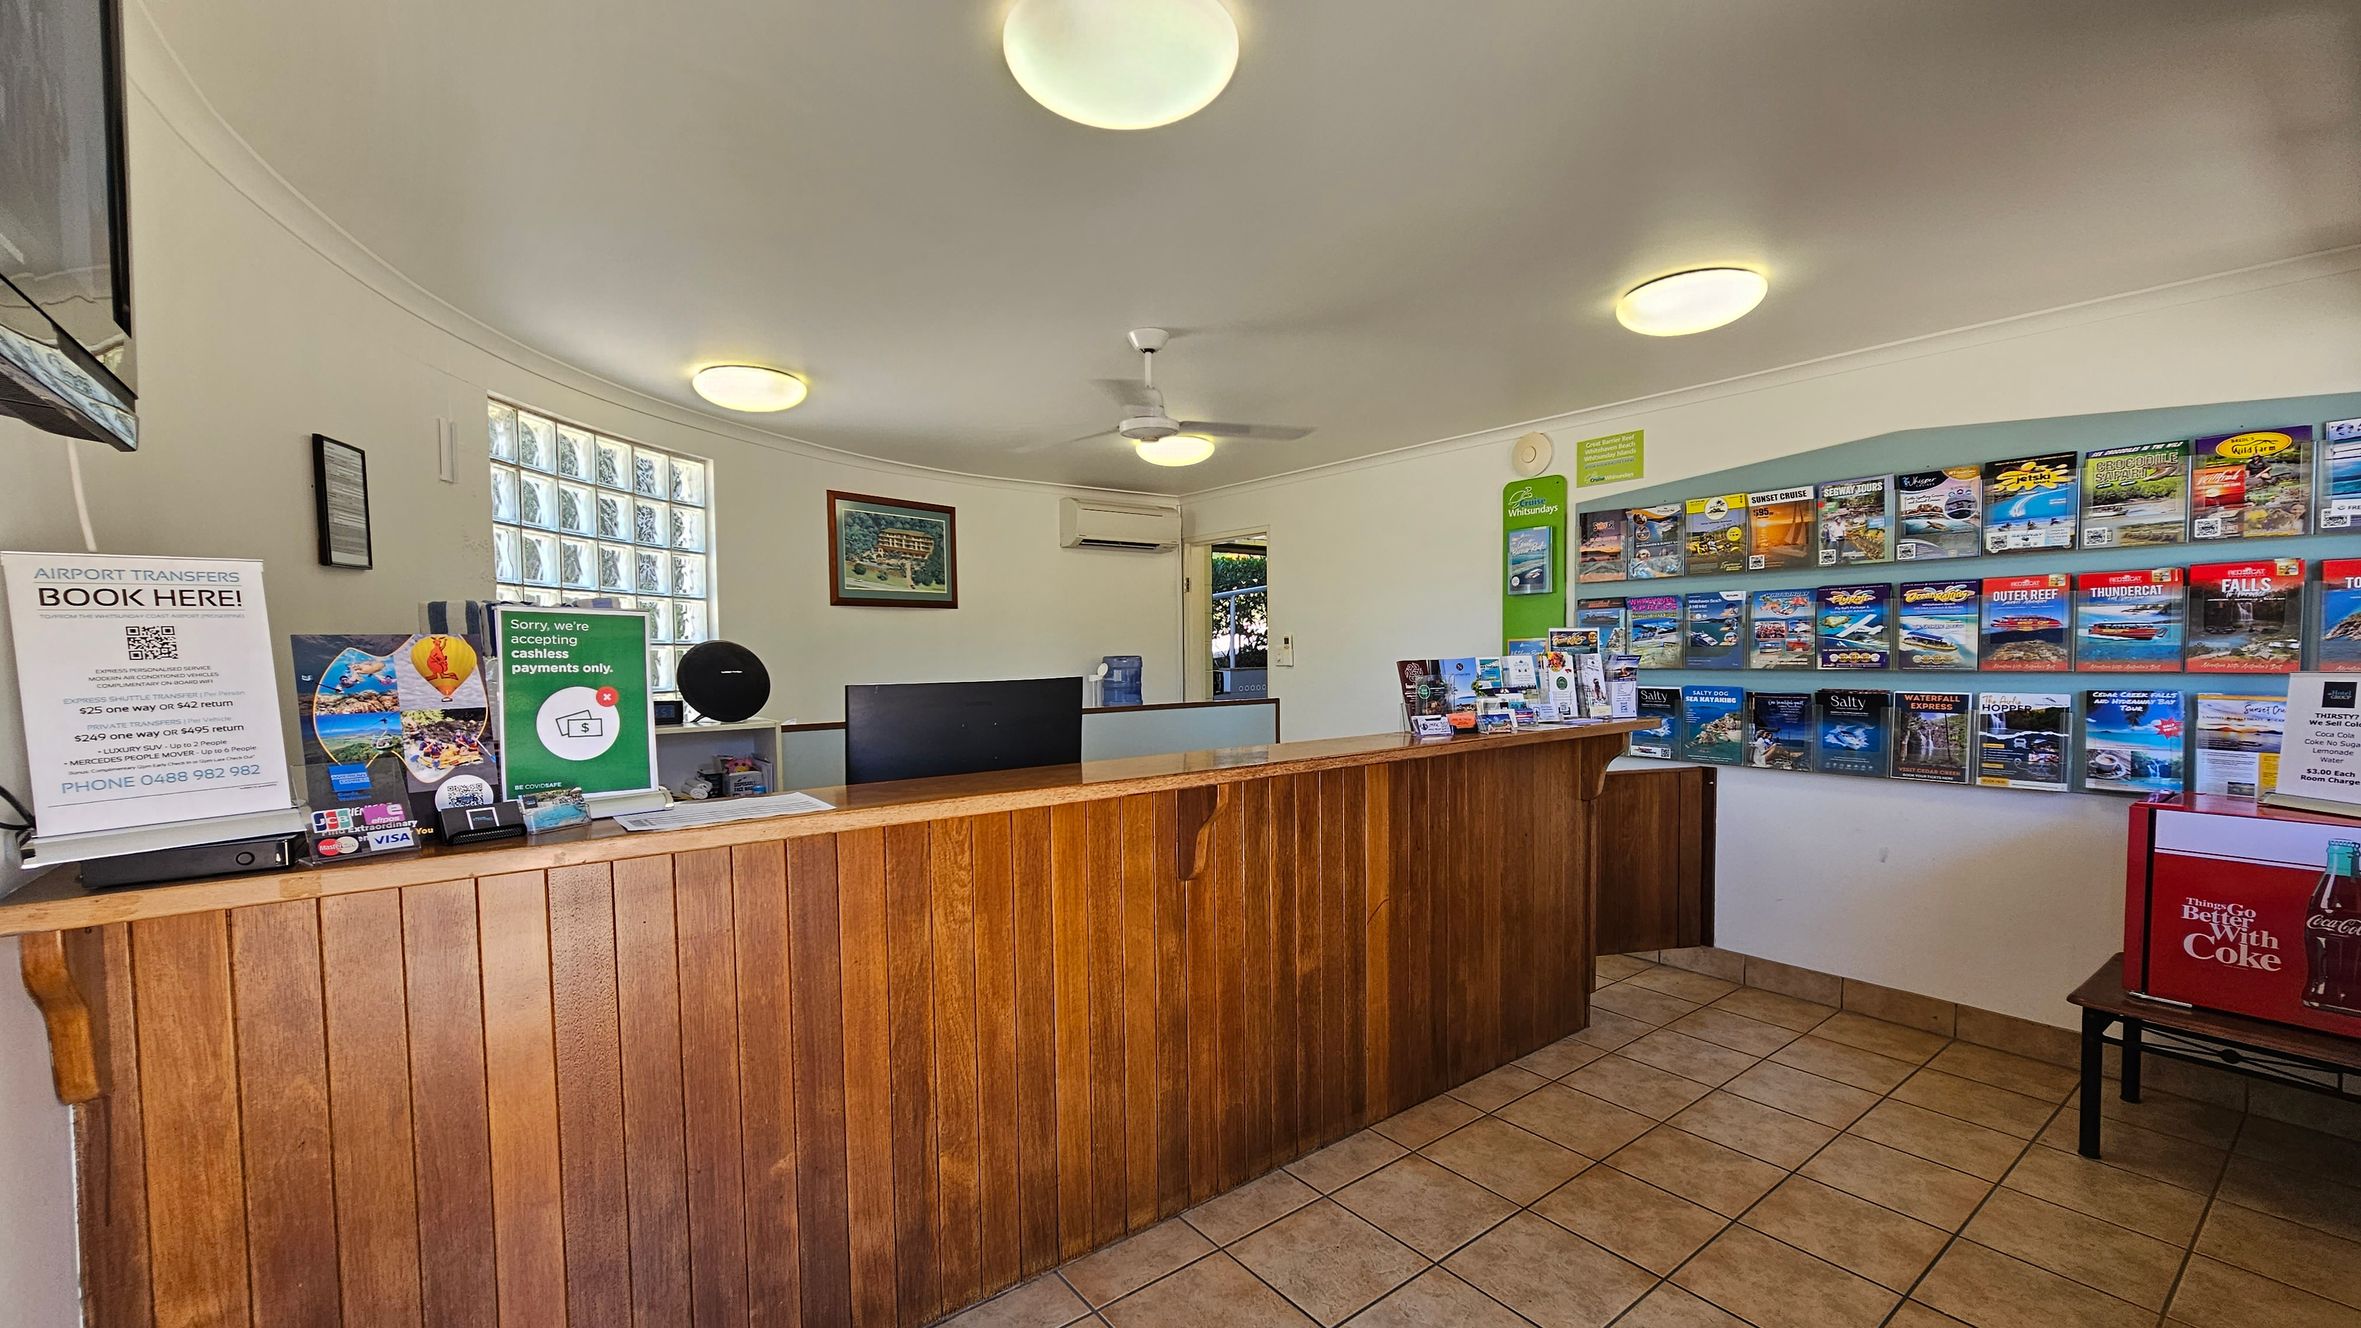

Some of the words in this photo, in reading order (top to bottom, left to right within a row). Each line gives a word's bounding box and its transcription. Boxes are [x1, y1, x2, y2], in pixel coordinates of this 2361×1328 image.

[2096, 451, 2178, 472] CROCODILE
[2015, 472, 2051, 484] jetski
[2095, 466, 2148, 482] SAFARI
[1824, 486, 1855, 497] SEGWAY
[1855, 482, 1883, 493] TOURS
[1519, 499, 1545, 507] Cruise
[1751, 495, 1778, 504] SUNSET
[1780, 490, 1807, 500] CRUISE
[1508, 505, 1558, 517] Whitsundays
[34, 568, 125, 581] AIRPORT
[131, 570, 240, 583] TRANSFERS
[2221, 577, 2273, 592] FALLS
[38, 588, 145, 607] BOOK
[154, 589, 242, 607] HERE!
[1993, 590, 2028, 601] OUTER
[2031, 589, 2058, 600] REEF
[2090, 585, 2164, 598] THUNDERCAT
[510, 619, 550, 631] Sorry,
[554, 621, 589, 631] we're
[511, 634, 578, 646] accepting
[511, 648, 569, 659] cashless
[512, 663, 579, 674] payments
[583, 663, 613, 675] only.
[63, 696, 107, 705] EXPRESS
[109, 694, 151, 702] SHUTTLE
[152, 692, 198, 700] TRANSFER
[1640, 690, 1668, 703] Salty
[1830, 695, 1866, 710] Salty
[1904, 694, 1961, 702] WATERFALL
[1982, 695, 1997, 705] The
[79, 705, 103, 715] $25
[132, 704, 156, 712] way
[159, 703, 174, 711] OR
[177, 701, 198, 709] $42
[201, 700, 233, 708] return
[1910, 702, 1953, 710] EXPRESS
[1982, 704, 2032, 713] HOPPER
[2244, 704, 2269, 714] Sunset
[87, 722, 127, 731] PRIVATE
[130, 718, 182, 728] TRANSFERS
[74, 733, 106, 743] $249
[110, 732, 133, 740] one
[136, 730, 160, 739] way
[163, 729, 178, 737] OR
[181, 725, 209, 735] $495
[212, 724, 244, 733] return
[104, 746, 141, 754] LUXURY
[2312, 748, 2354, 756] Lemonade
[70, 756, 123, 766] MERCEDES
[124, 753, 160, 762] PEOPLE
[162, 750, 195, 758] MOVER
[62, 776, 135, 793] PHONE
[141, 771, 188, 786] 0488
[193, 767, 225, 780] 982
[230, 764, 260, 777] 982
[2328, 776, 2361, 786] Charge
[525, 781, 562, 790] COVIDSAFE
[347, 819, 417, 832] Extraordinary
[371, 814, 400, 824] eftpos
[415, 827, 434, 835] You
[375, 833, 410, 844] VISA
[2186, 897, 2228, 910] Things
[2227, 904, 2256, 918] Go
[2181, 904, 2254, 928] Better
[2306, 914, 2361, 935] Coca-Col
[2209, 923, 2280, 949] With
[2183, 933, 2282, 971] Coke
